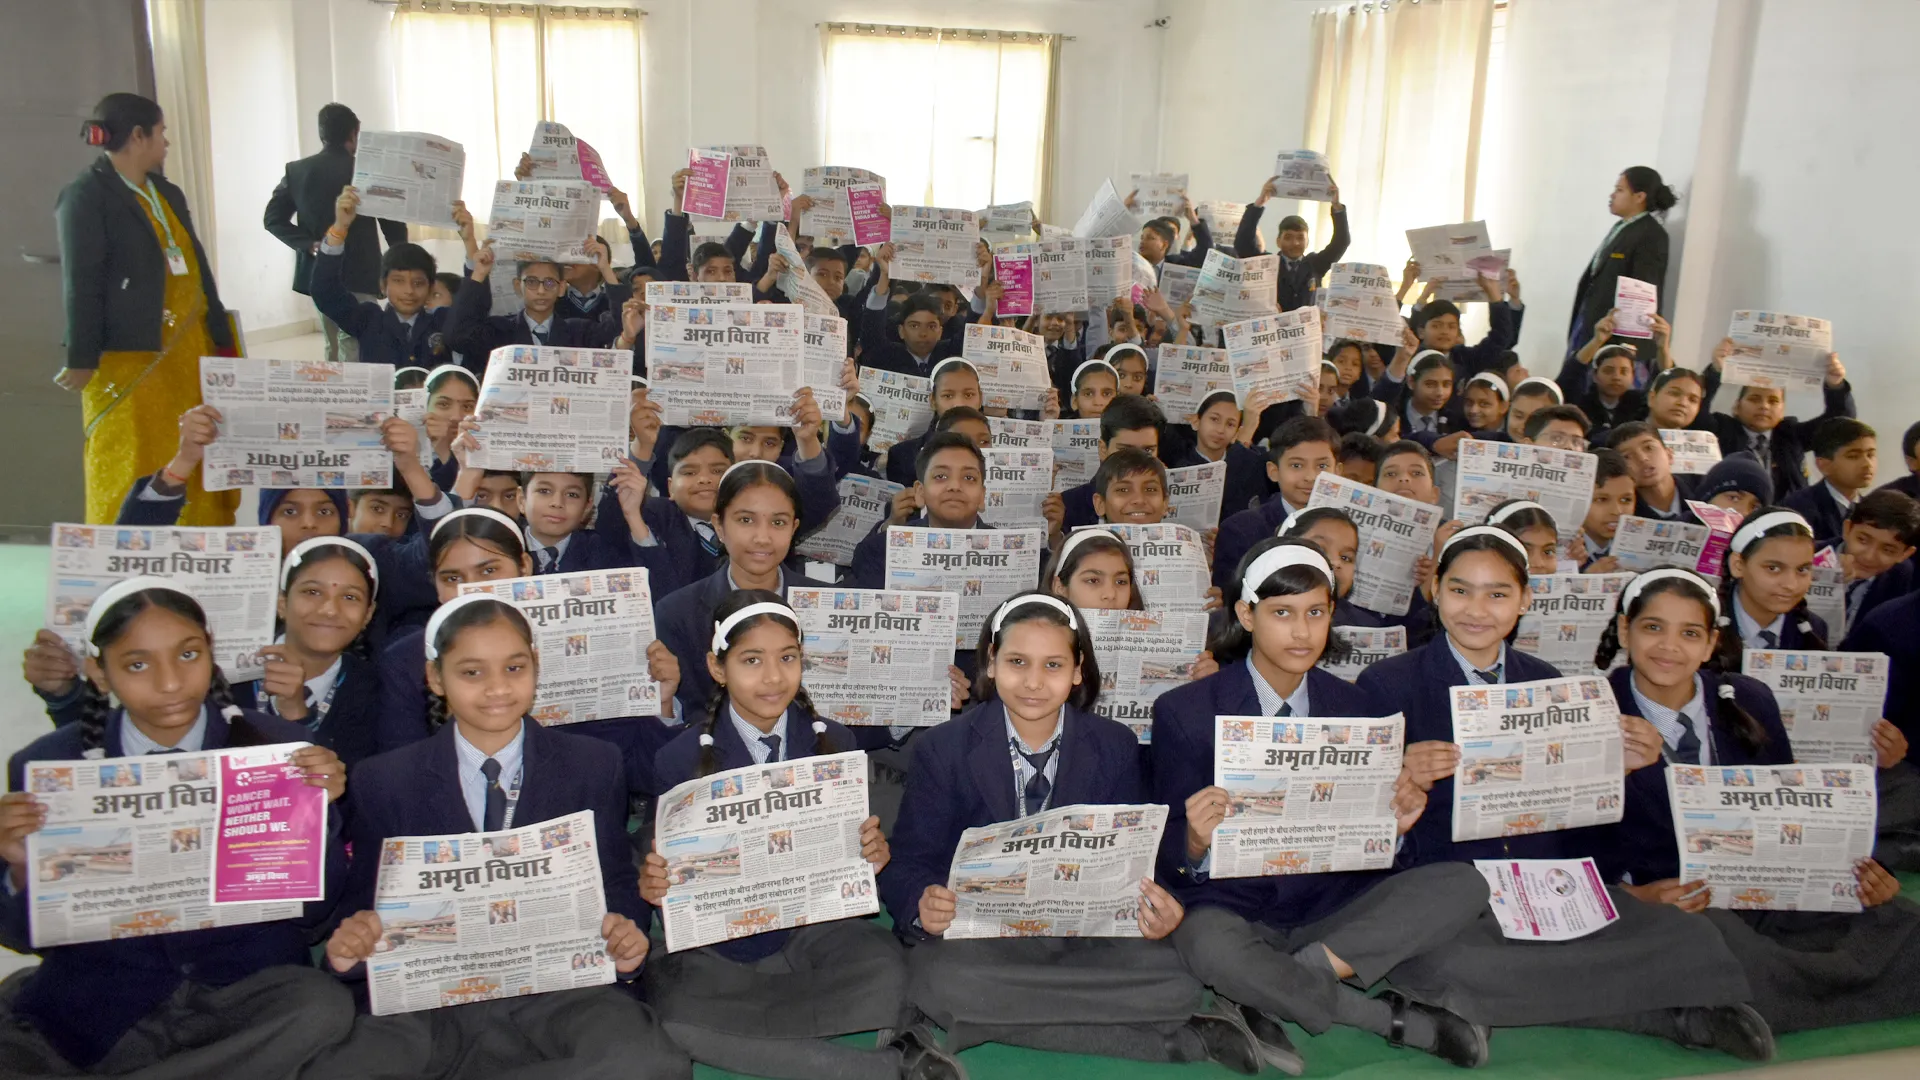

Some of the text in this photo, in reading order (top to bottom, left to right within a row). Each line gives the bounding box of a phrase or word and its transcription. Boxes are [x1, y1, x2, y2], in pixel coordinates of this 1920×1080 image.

[514, 195, 570, 210] अमृत विचार
[912, 219, 937, 232] अमृत
[683, 326, 770, 347] अमृत विचार
[1251, 326, 1306, 347] अमृत विचार
[507, 366, 598, 386] अमृत विचार
[1181, 361, 1230, 374] अमृत विचा
[877, 385, 901, 400] अमृत
[998, 433, 1029, 447] विचार
[989, 467, 1026, 481] विचार
[1491, 460, 1568, 483] अमृत विचार
[848, 494, 881, 512] विचार
[1378, 513, 1415, 537] विचार
[1142, 541, 1183, 557] विचार
[171, 552, 234, 575] विचार
[921, 550, 1010, 571] अमृत विचार
[523, 597, 617, 627] मृत विचार
[1563, 594, 1606, 612] विचार
[827, 611, 922, 635] अमृत विचार
[1779, 672, 1858, 693] अमृत विचार
[1500, 704, 1591, 734] अमृत विचार
[1264, 745, 1372, 771] अमृत विचार
[92, 784, 217, 819] अमृत विच
[226, 789, 272, 804] CANCER
[226, 797, 292, 815] WON'T WAIT.
[706, 798, 763, 824] अमृत
[764, 787, 824, 813] विचार
[1720, 787, 1834, 811] अमृत विचार
[225, 811, 271, 826] NEITHER
[223, 821, 291, 838] SHOULD WE.
[1001, 831, 1119, 855] अमृत विचार
[418, 856, 553, 892] अमृत विचार
